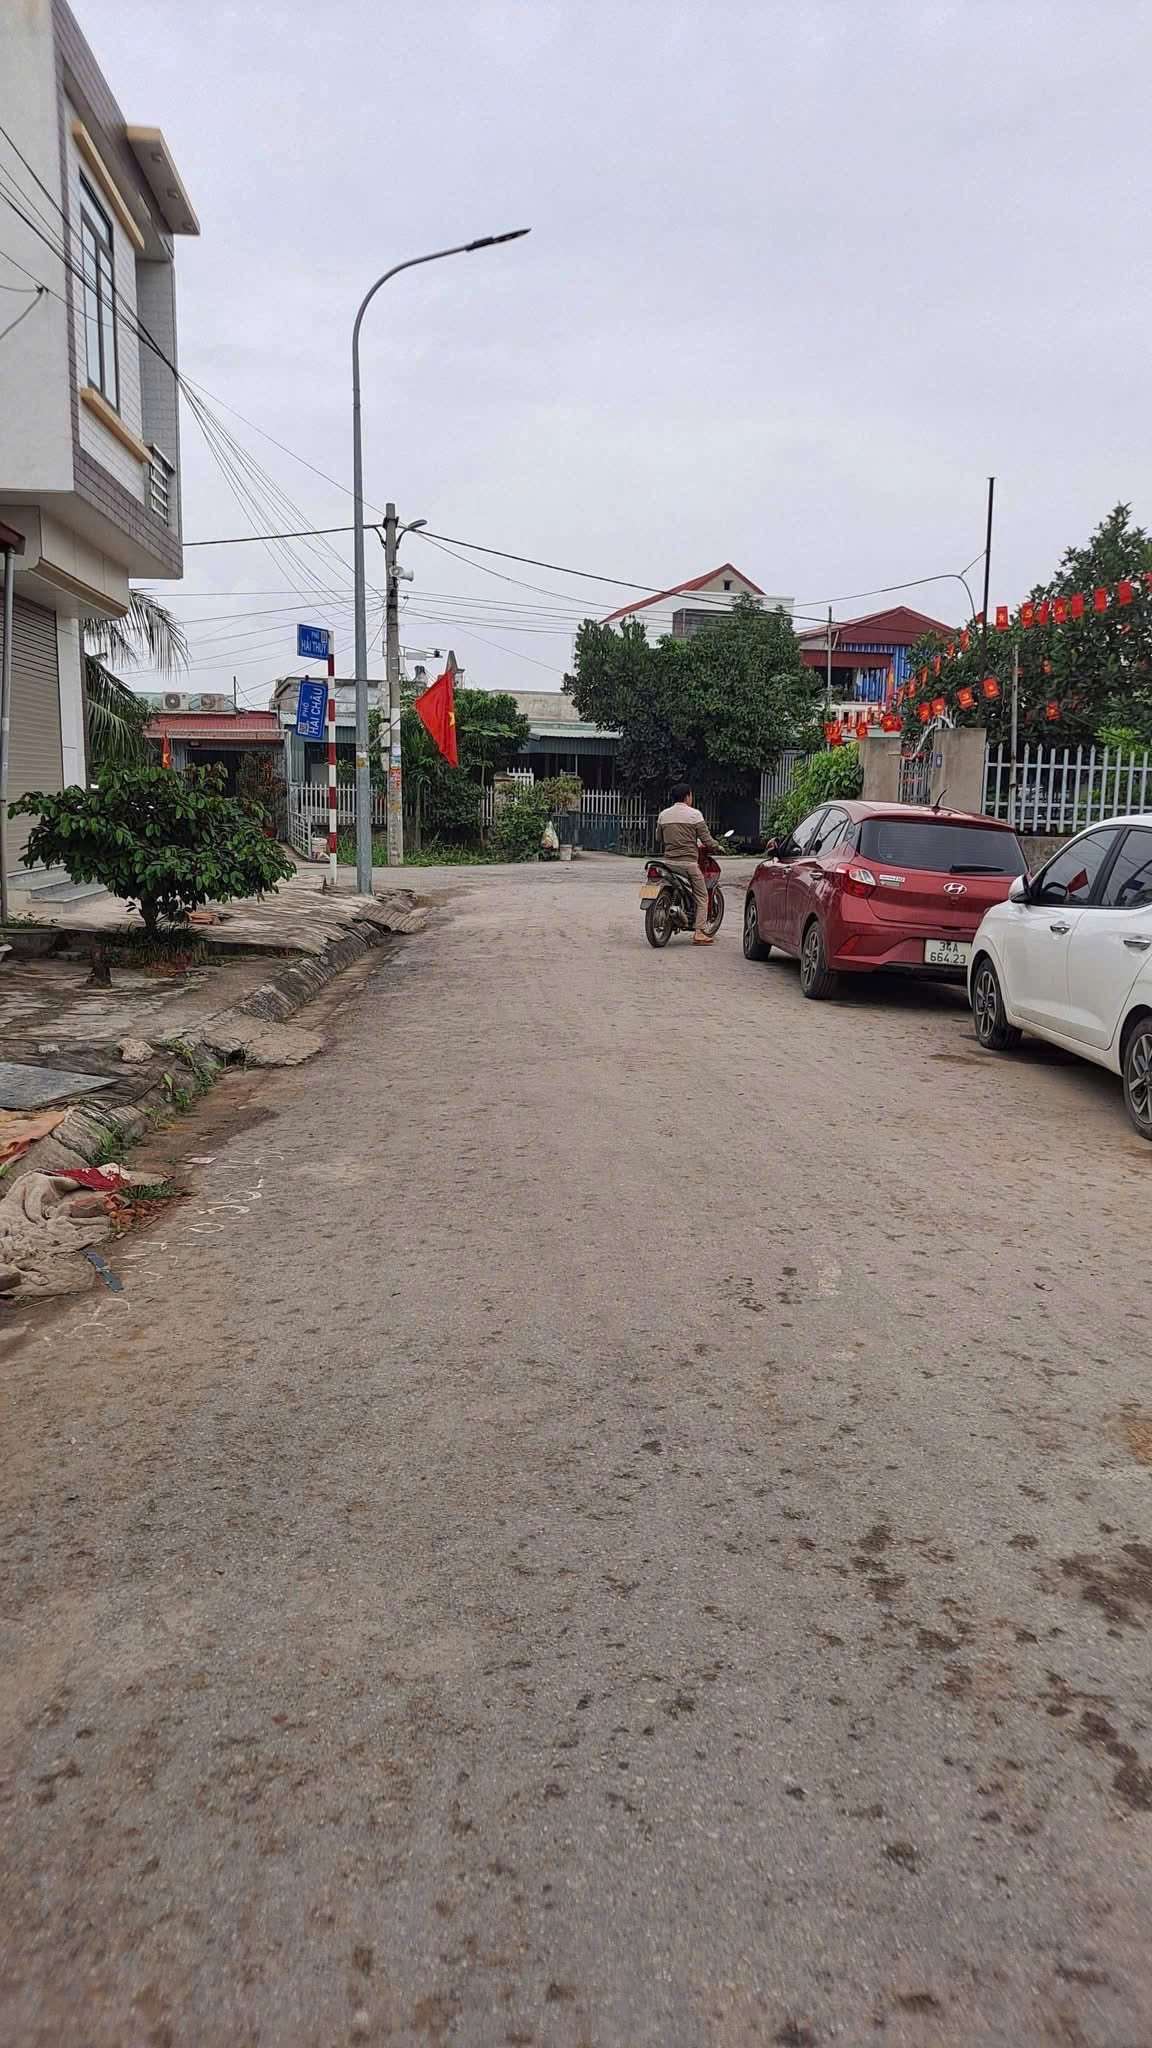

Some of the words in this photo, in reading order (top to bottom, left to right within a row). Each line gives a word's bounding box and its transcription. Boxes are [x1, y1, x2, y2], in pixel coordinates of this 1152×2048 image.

[306, 717, 320, 735] HẢI
[939, 941, 959, 953] 34A
[930, 952, 966, 964] 664.23
